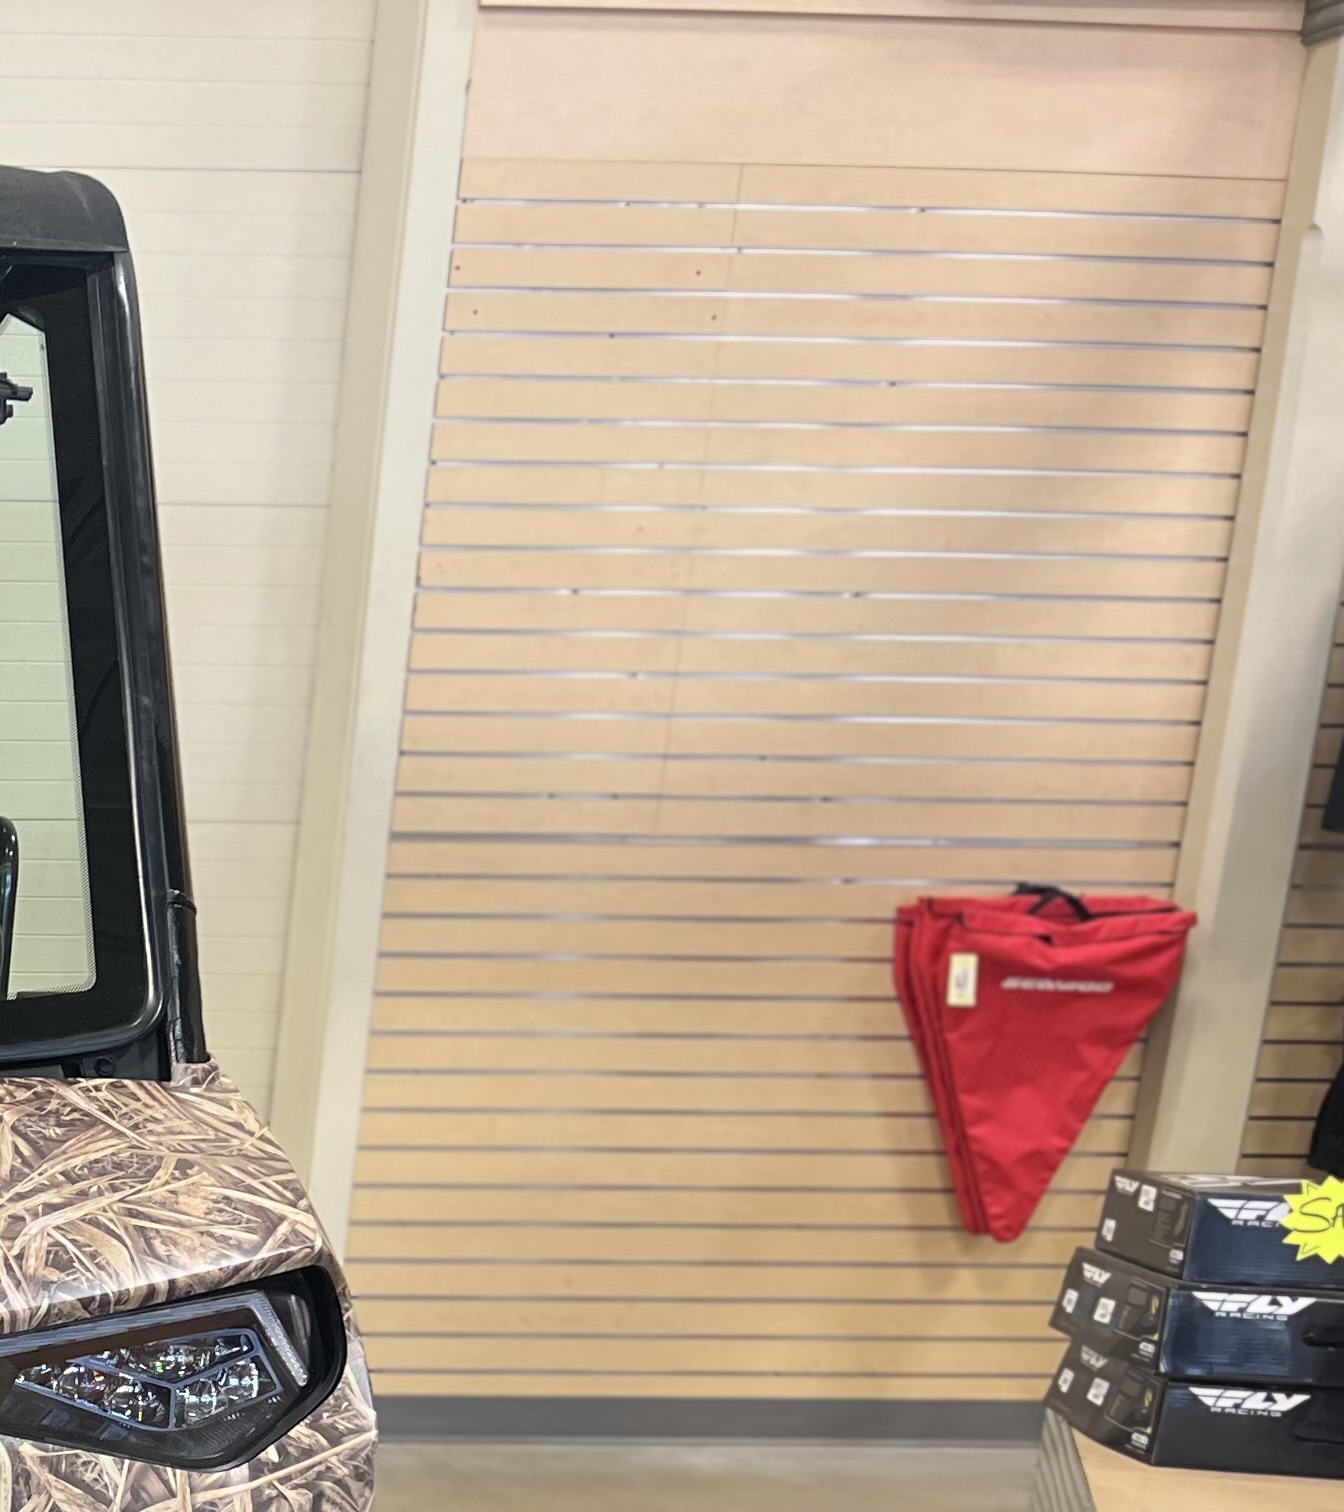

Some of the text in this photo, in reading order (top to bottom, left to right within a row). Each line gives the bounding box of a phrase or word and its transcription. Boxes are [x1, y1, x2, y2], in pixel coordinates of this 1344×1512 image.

[1192, 1291, 1316, 1315] FLY
[1215, 1311, 1288, 1321] RACING
[1189, 1387, 1311, 1412] FLY
[1211, 1407, 1281, 1417] RACING
